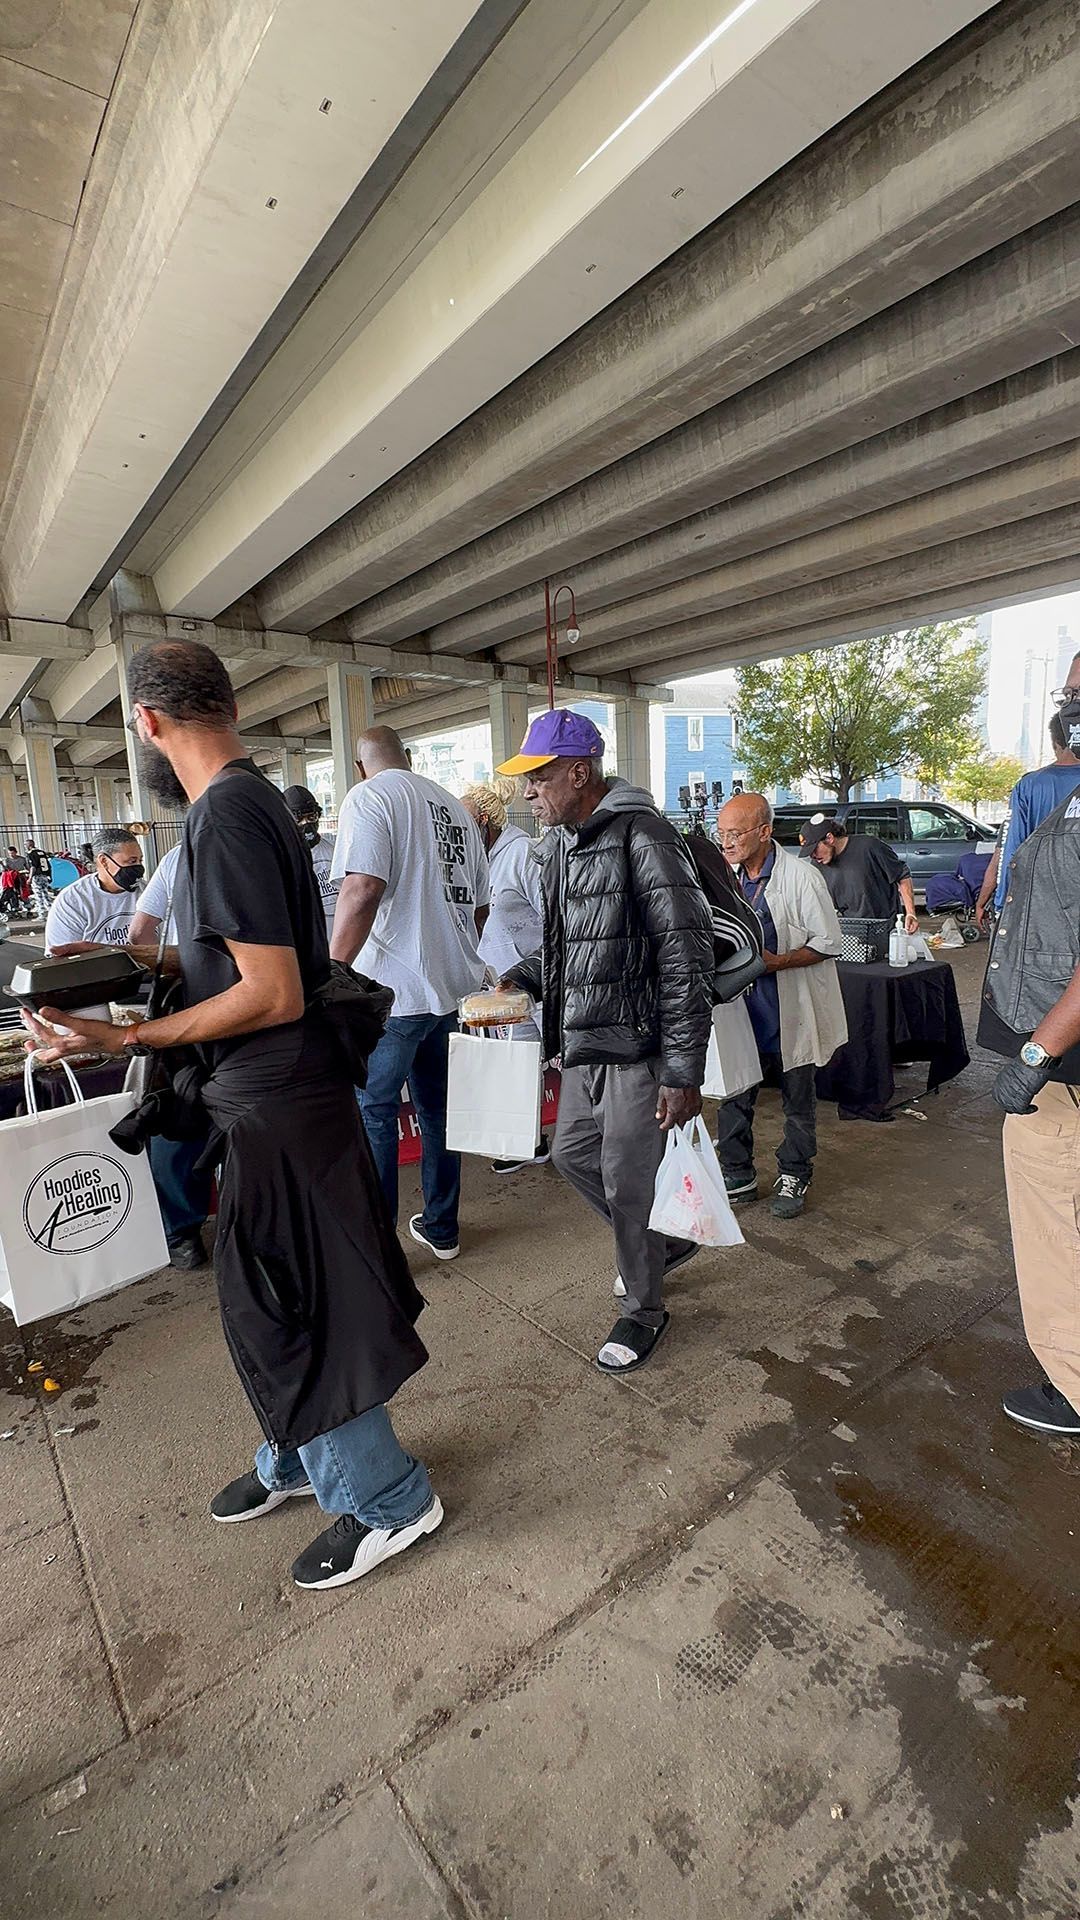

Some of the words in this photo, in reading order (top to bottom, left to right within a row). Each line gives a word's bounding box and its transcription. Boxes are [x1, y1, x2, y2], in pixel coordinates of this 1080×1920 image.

[427, 800, 452, 824] TIS
[442, 863, 454, 884] HE
[442, 884, 475, 905] UELL
[104, 924, 130, 941] Hood
[43, 1168, 102, 1201] Hoodies
[63, 1182, 122, 1217] Healing
[57, 1210, 119, 1235] FOUNDATION
